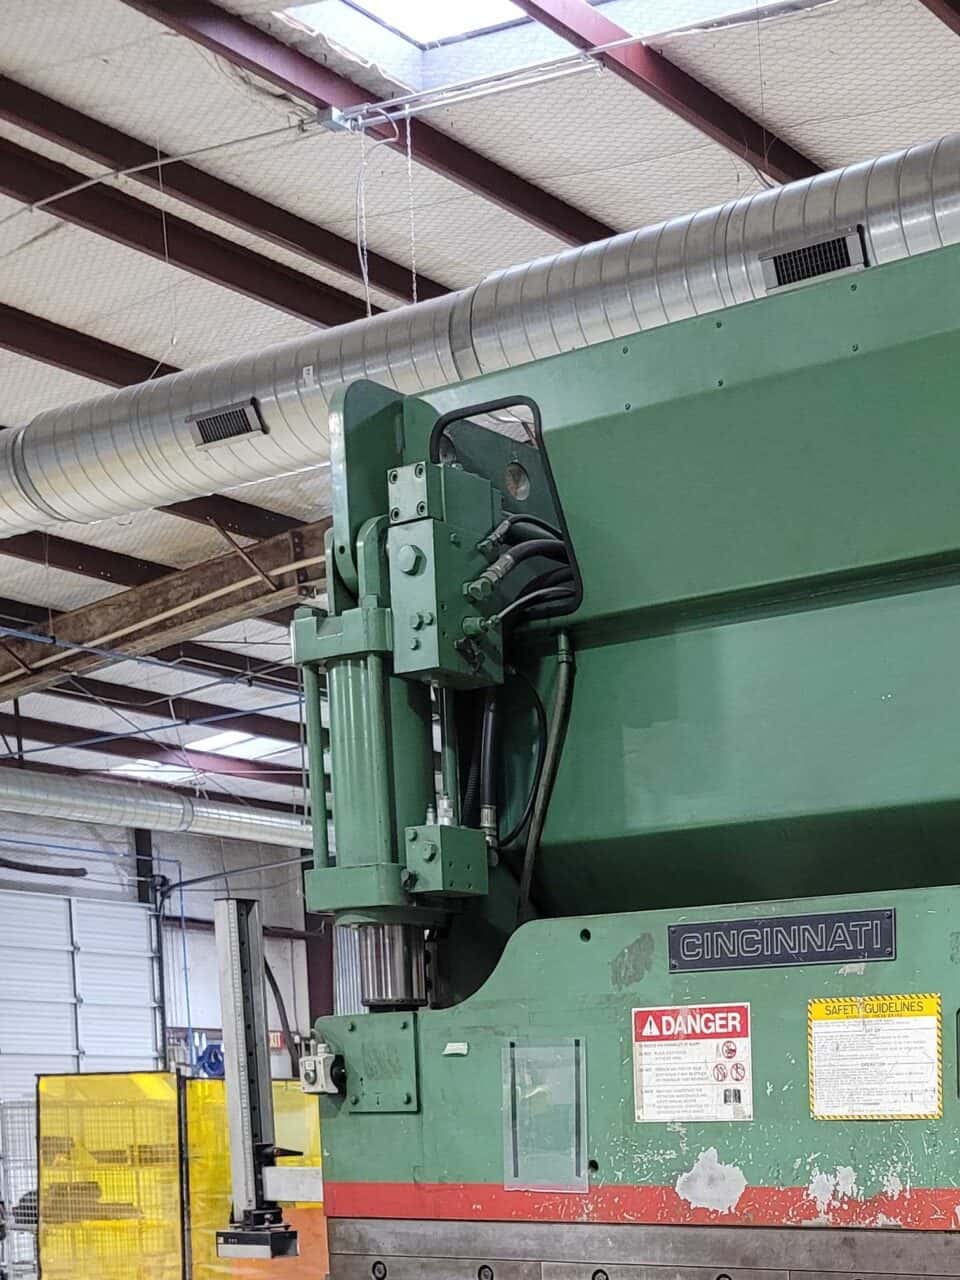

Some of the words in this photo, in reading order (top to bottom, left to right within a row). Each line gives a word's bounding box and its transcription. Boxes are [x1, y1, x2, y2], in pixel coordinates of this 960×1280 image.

[680, 920, 882, 961] CINCINNATI
[825, 1003, 861, 1016] SAFETY
[864, 1001, 924, 1014] GUIDELINES
[661, 1012, 742, 1036] DANGER
